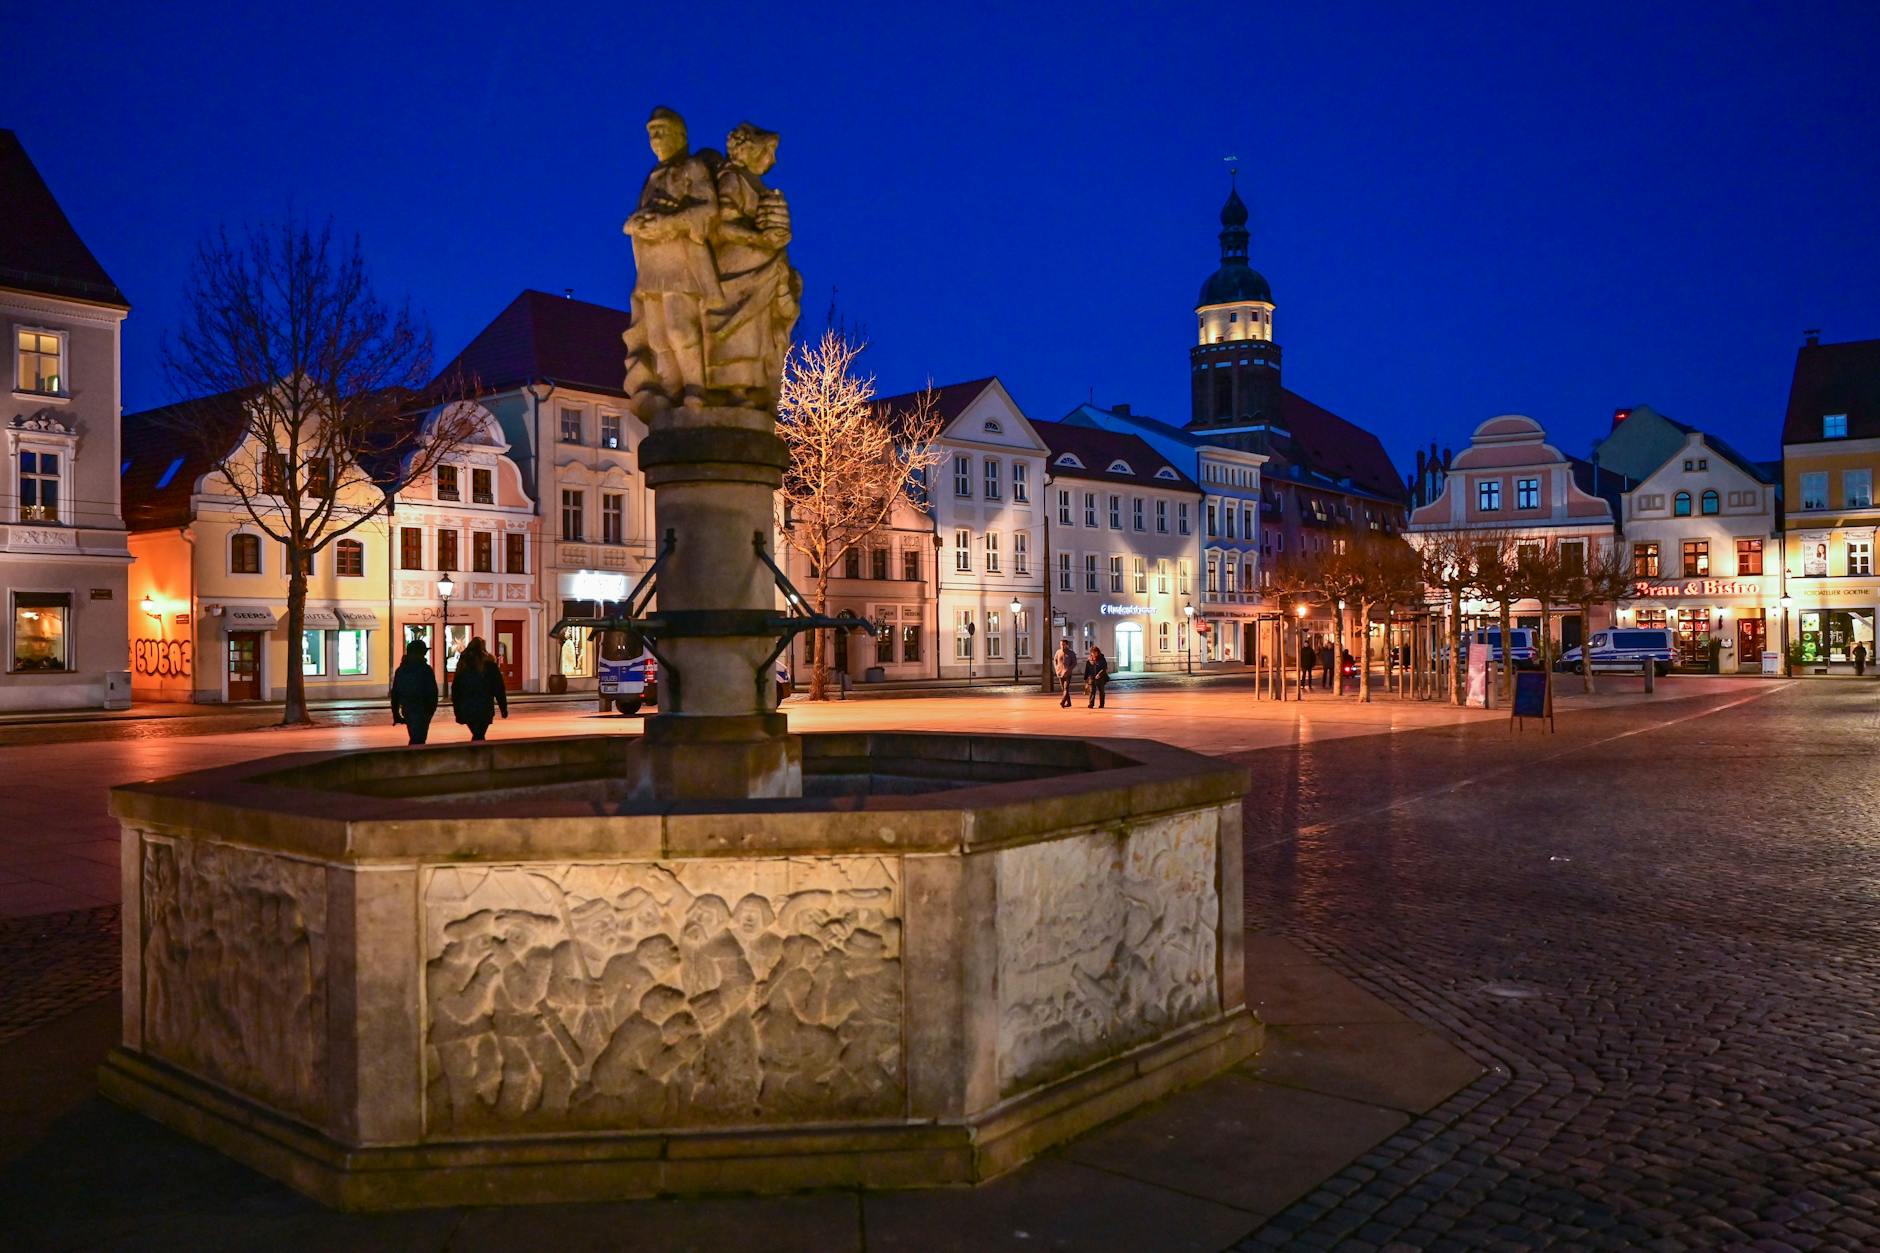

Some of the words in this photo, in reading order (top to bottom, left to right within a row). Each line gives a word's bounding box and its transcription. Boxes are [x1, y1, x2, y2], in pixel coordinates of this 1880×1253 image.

[1636, 581, 1680, 596] Brau
[1684, 581, 1699, 595] &
[1702, 579, 1760, 595] Bistro
[1843, 588, 1870, 596] GOETHE
[233, 611, 267, 620] GEERS
[342, 611, 377, 621] HÖREN
